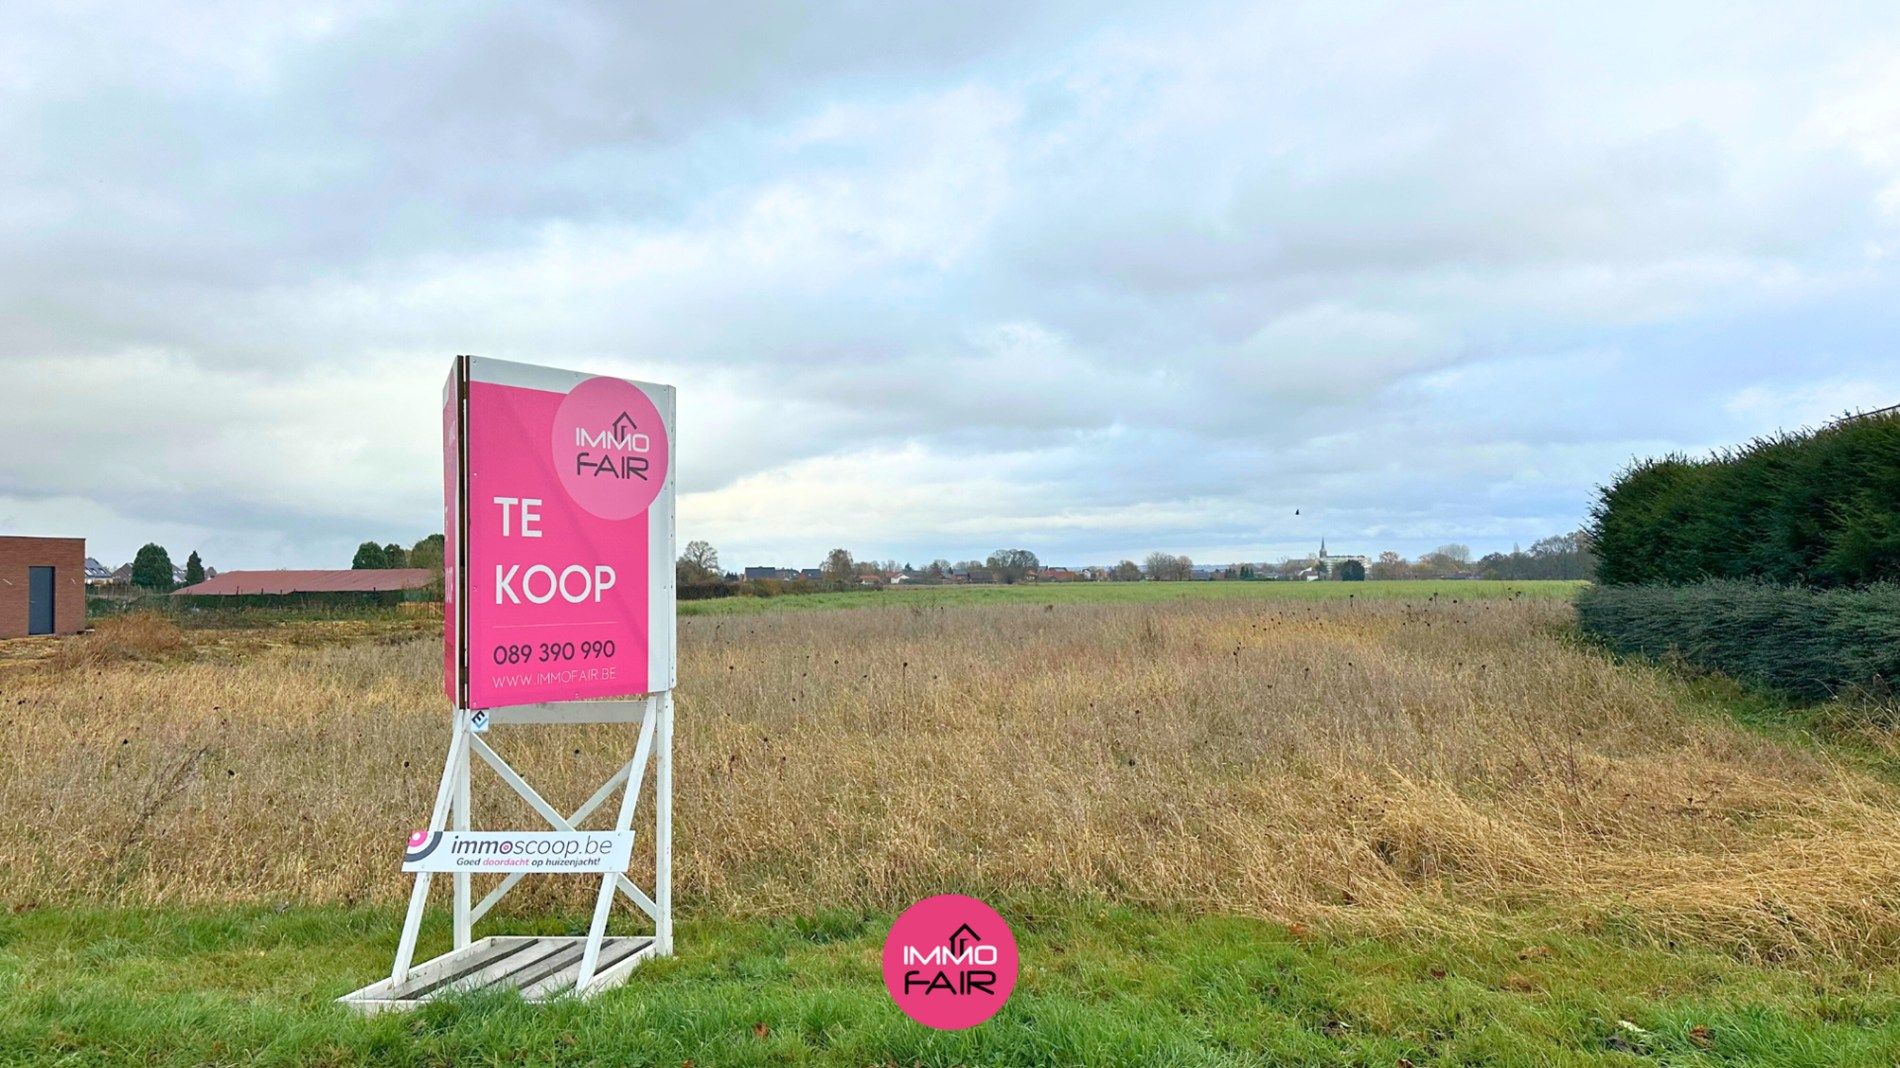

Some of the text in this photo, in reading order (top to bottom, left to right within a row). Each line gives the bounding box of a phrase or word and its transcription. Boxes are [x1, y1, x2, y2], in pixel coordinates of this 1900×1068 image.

[576, 427, 649, 453] IMMO
[577, 452, 648, 480] FAIR
[493, 496, 542, 538] TE
[495, 564, 616, 604] KOOP
[493, 640, 615, 665] 089 390 990
[492, 667, 617, 688] WWWIMMOFAIRBE
[451, 835, 612, 858] immoscoop.be
[456, 857, 601, 868] Goed doordacht op huizenjacht!
